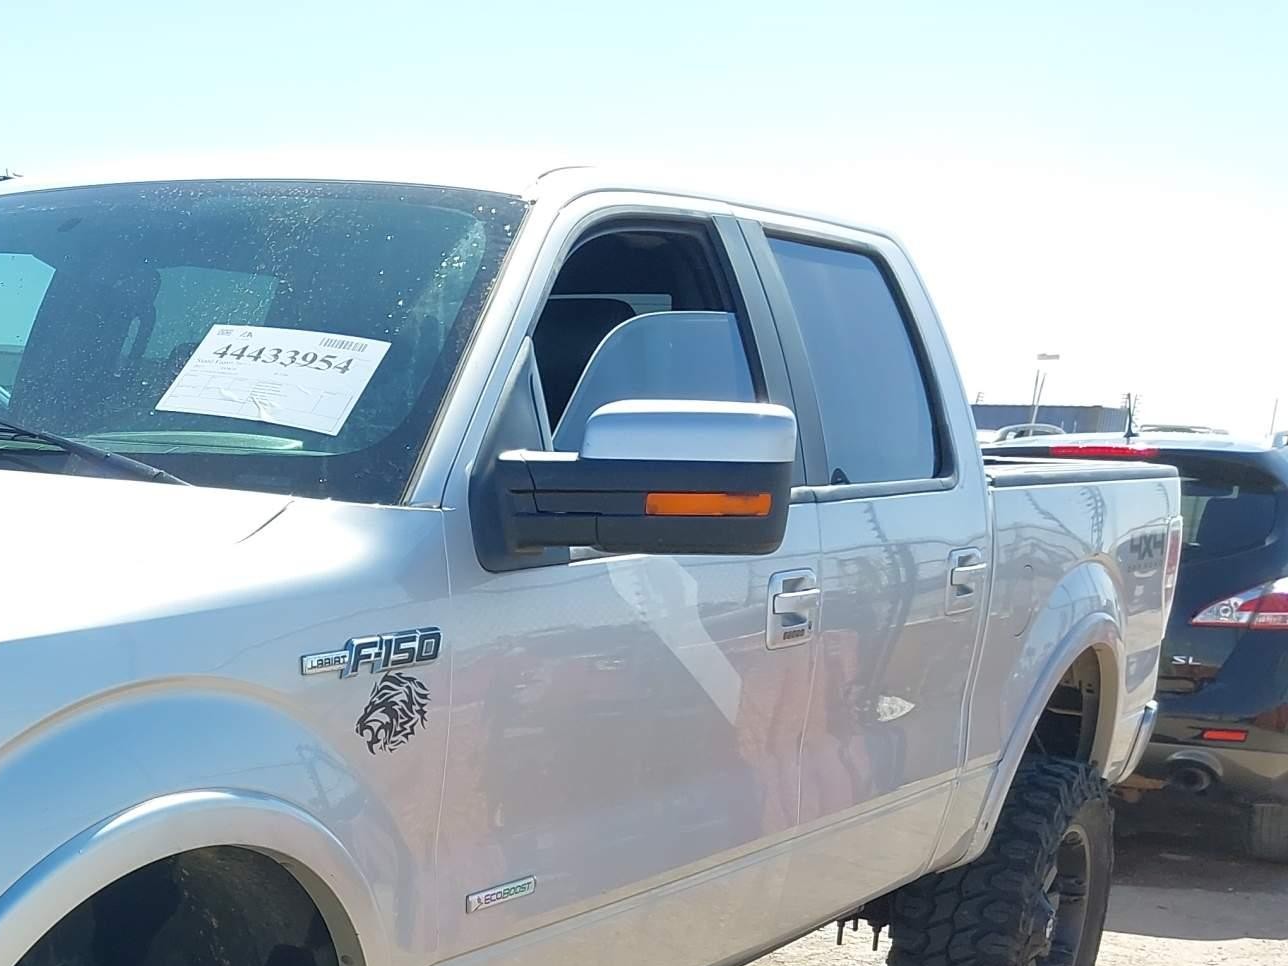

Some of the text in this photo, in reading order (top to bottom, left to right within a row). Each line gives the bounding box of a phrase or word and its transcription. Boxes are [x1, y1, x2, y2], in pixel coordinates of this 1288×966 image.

[212, 343, 354, 375] 44433954
[308, 628, 442, 677] LARIAT F-150
[1172, 655, 1201, 665] SL
